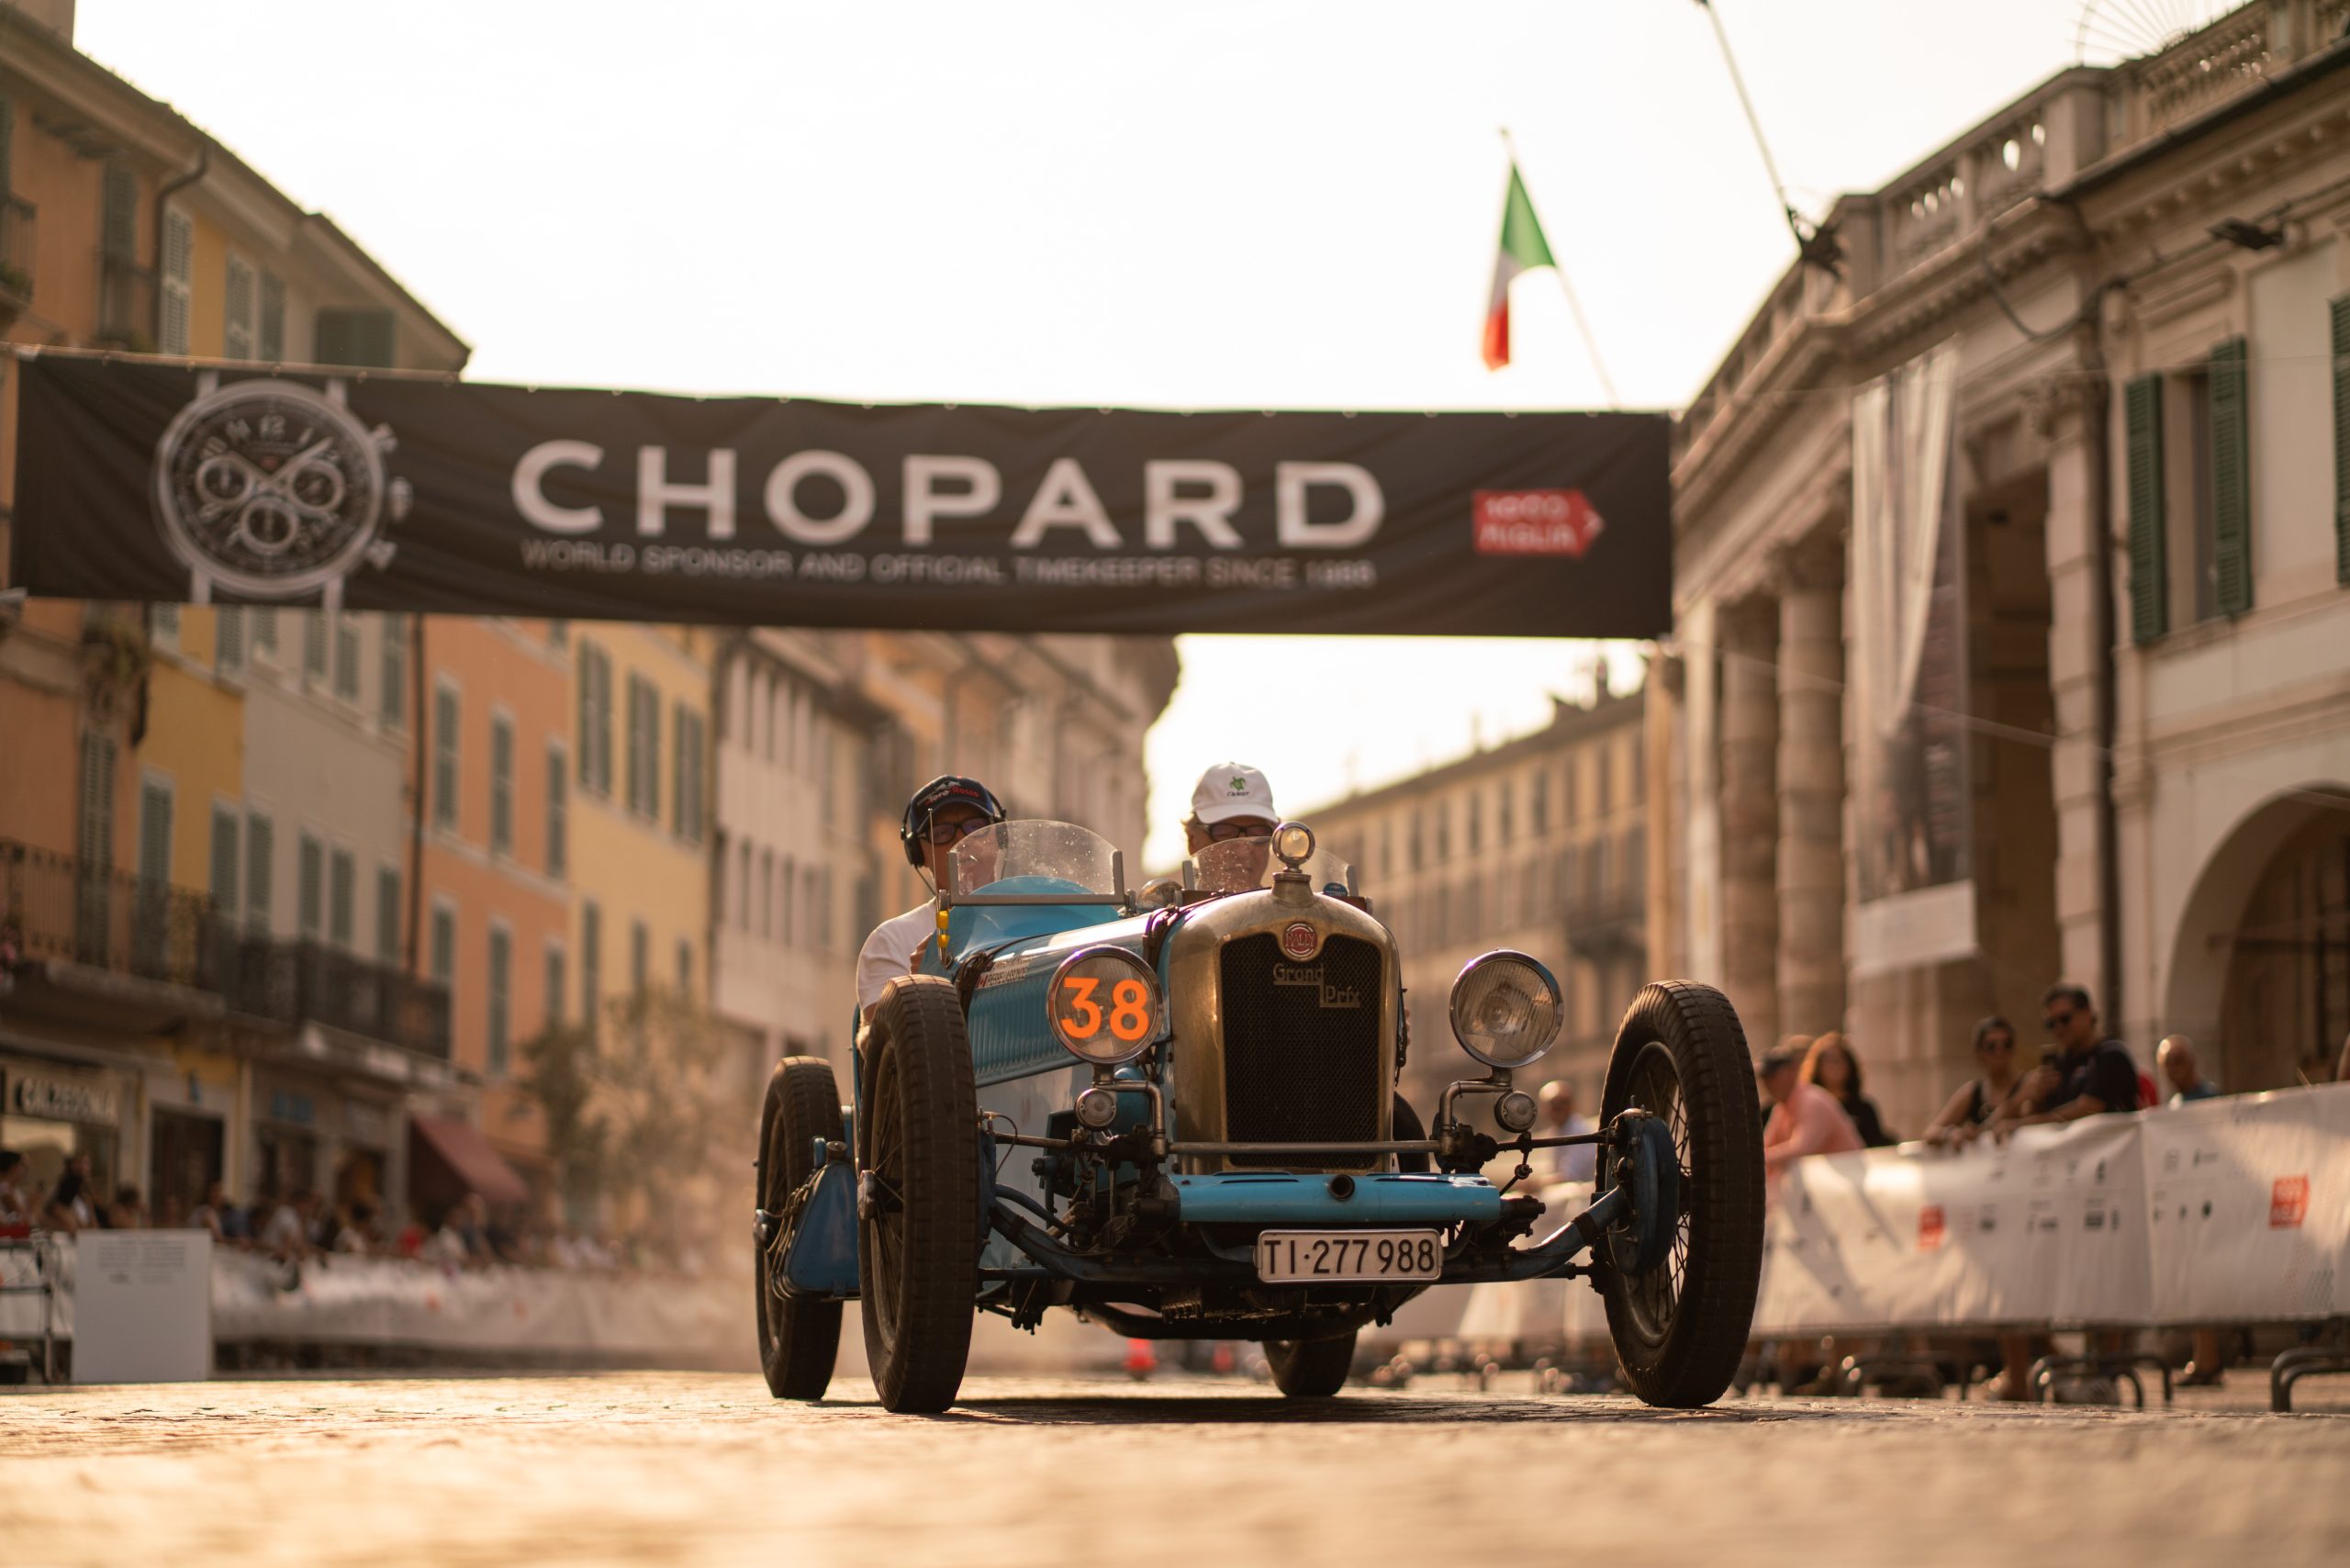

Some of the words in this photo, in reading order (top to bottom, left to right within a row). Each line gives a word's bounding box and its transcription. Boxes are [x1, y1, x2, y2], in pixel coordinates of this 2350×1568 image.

[511, 439, 1384, 546] CHOPARD
[520, 538, 636, 573] WORLD
[643, 545, 794, 577] SPONSOR
[797, 551, 867, 582] AND
[872, 554, 1007, 585] OFFICIAL
[1014, 557, 1201, 588] TIMEKEEPER
[1205, 558, 1299, 589] SINCE
[1285, 931, 1315, 947] RALLY
[1273, 962, 1324, 981] Grand
[1060, 977, 1149, 1041] 38
[1325, 985, 1360, 1003] Prix
